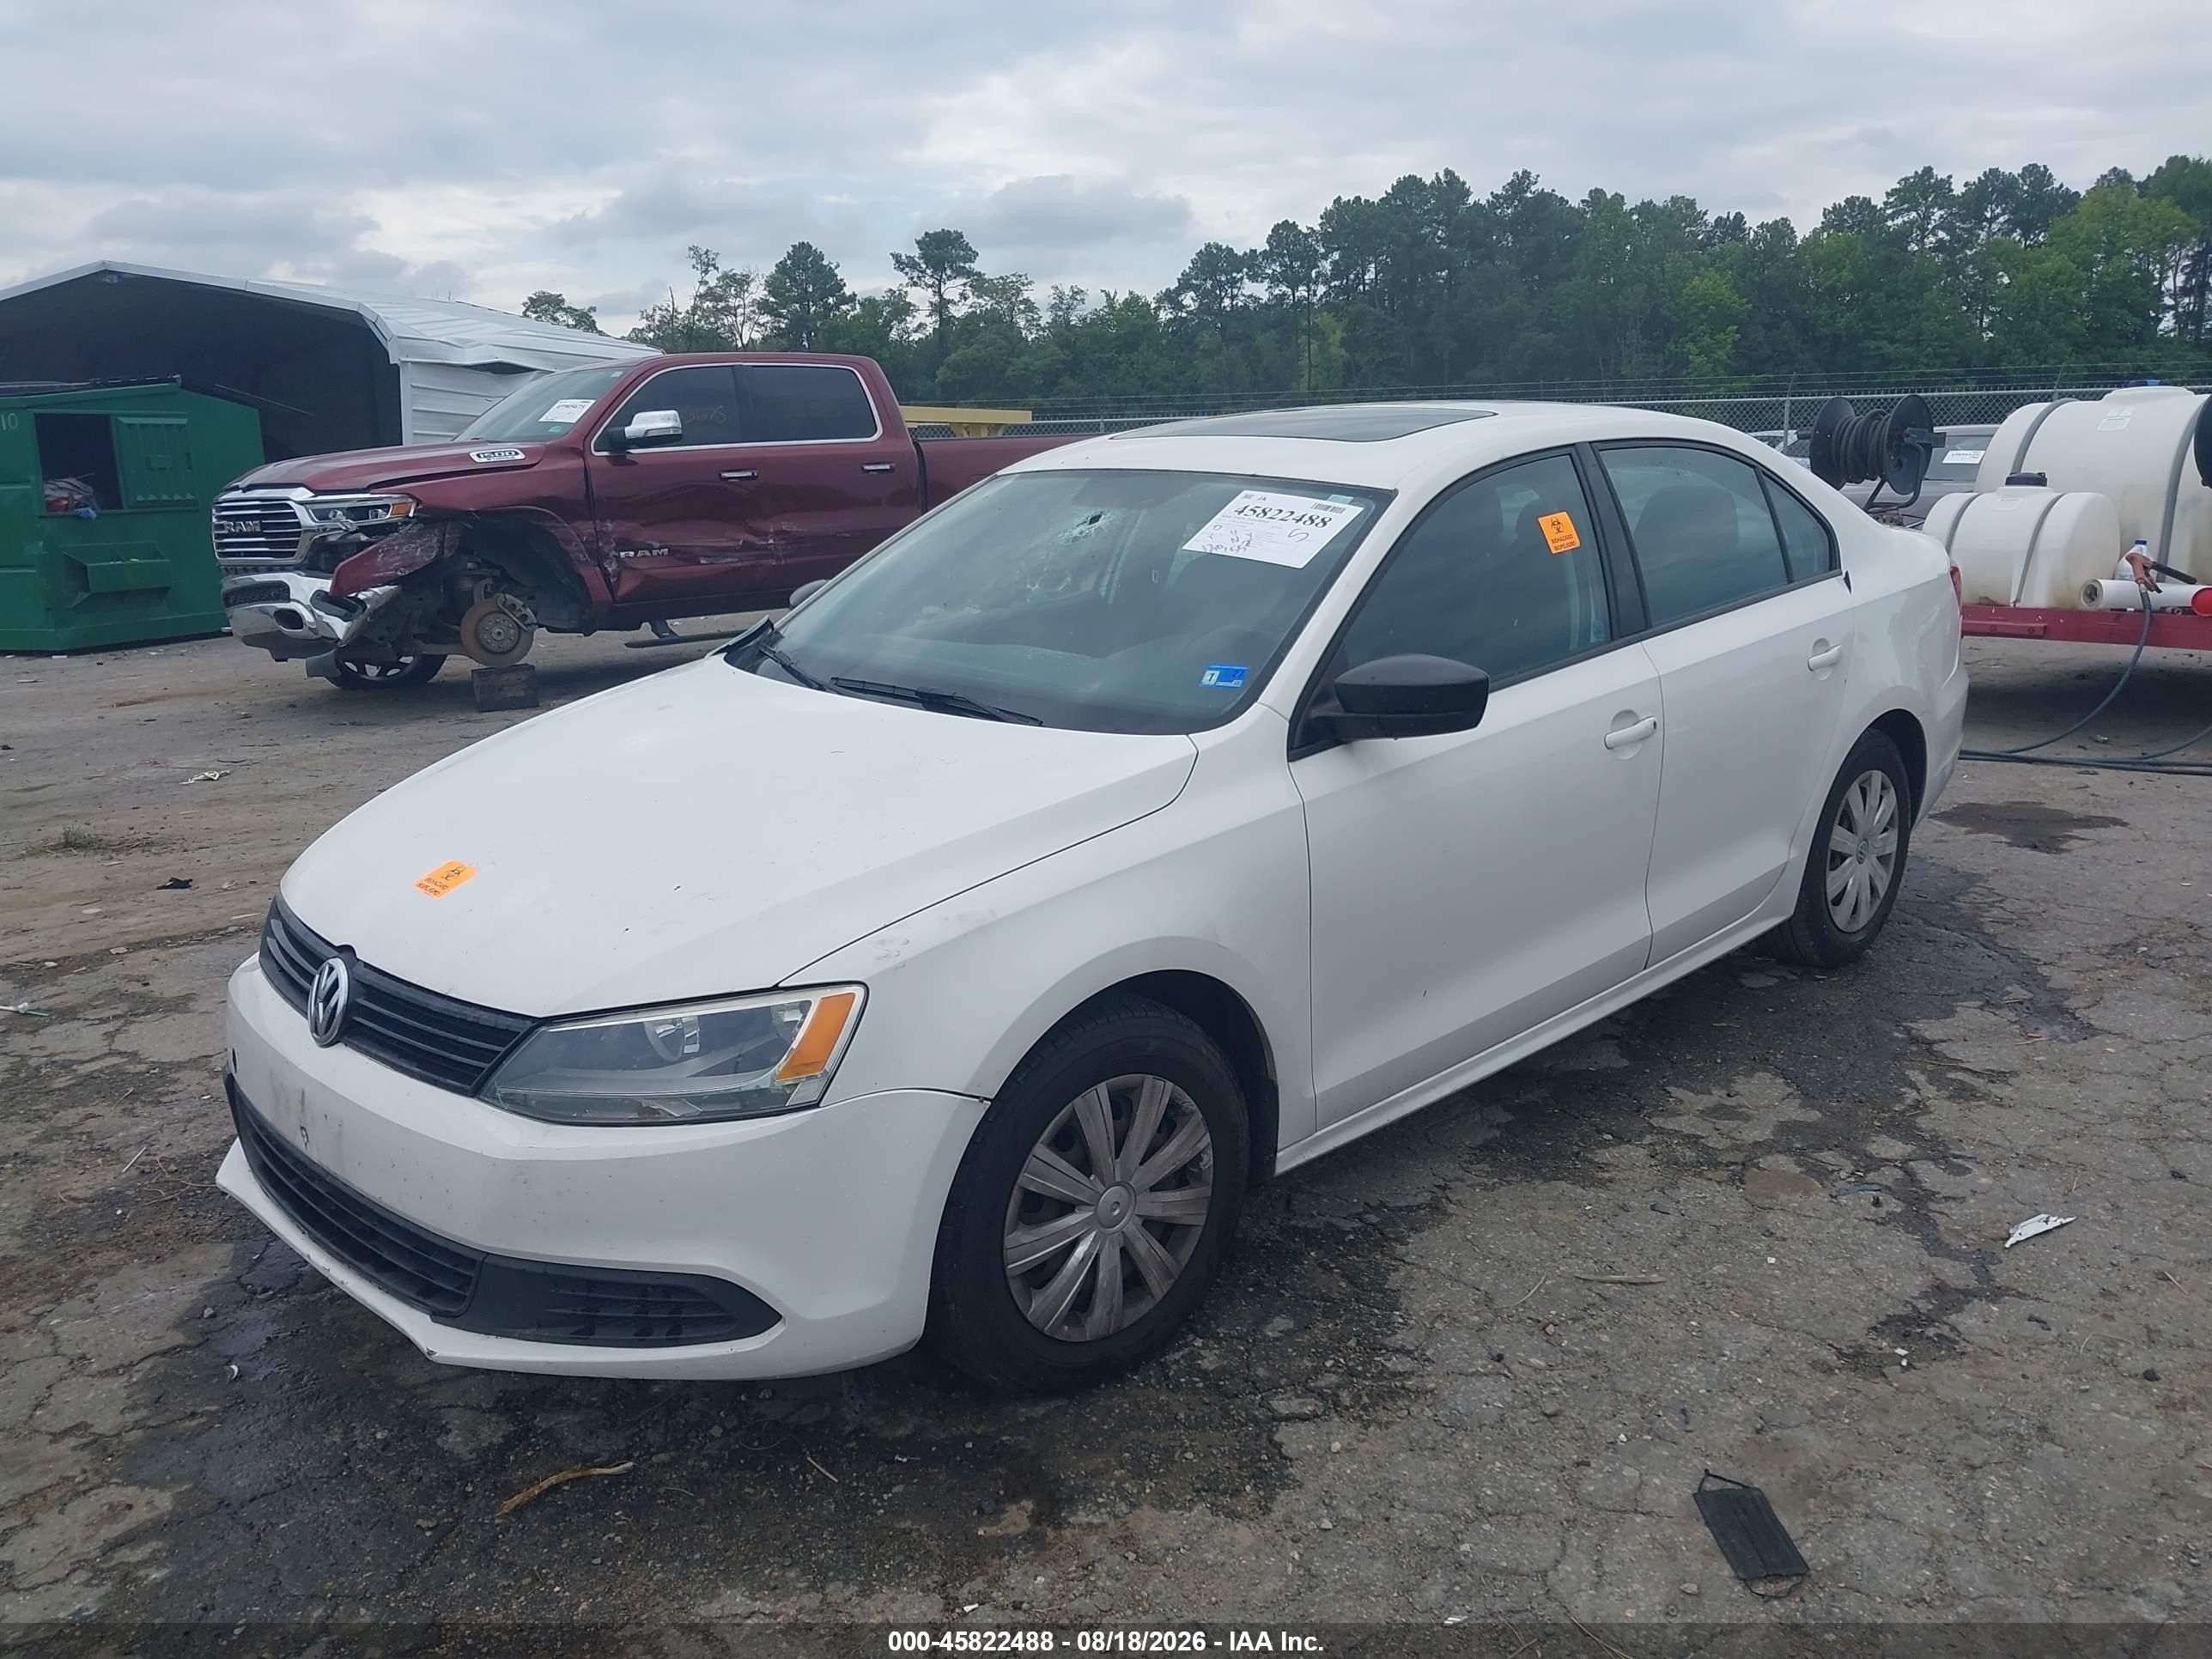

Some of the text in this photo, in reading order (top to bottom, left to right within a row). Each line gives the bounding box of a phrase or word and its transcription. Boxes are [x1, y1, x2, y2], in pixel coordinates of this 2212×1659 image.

[1234, 504, 1333, 528] 45822488
[223, 520, 262, 532] RAM
[619, 548, 669, 558] RAM
